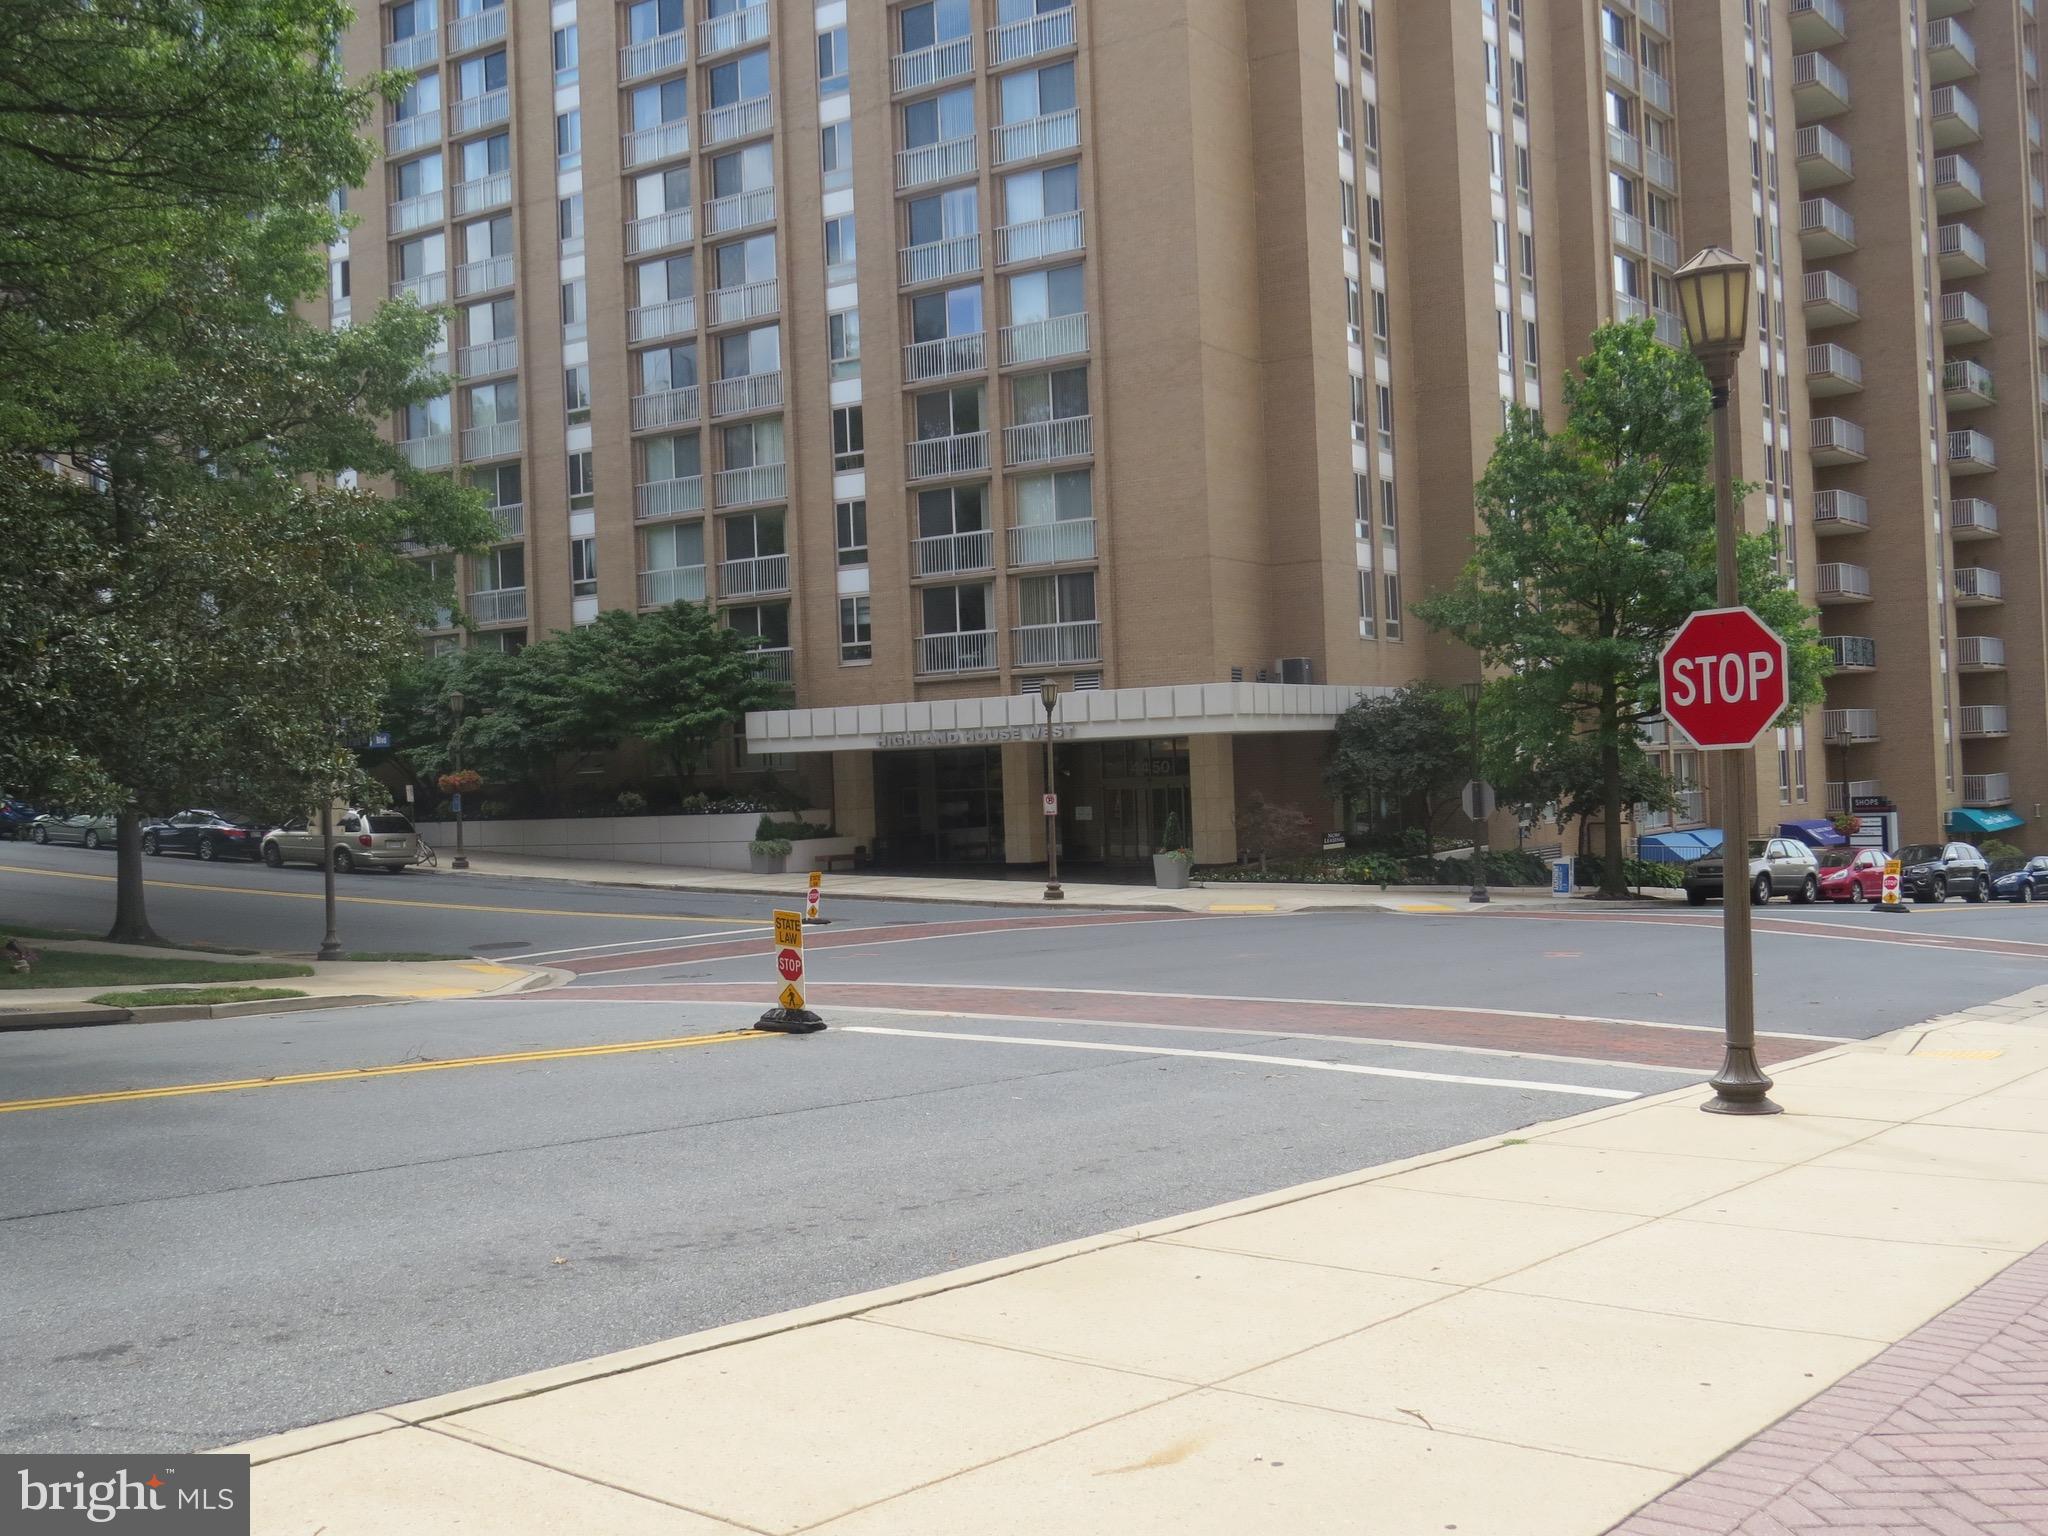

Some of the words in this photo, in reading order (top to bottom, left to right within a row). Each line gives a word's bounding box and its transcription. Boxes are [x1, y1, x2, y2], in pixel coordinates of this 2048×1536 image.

[1672, 651, 1774, 707] STOP
[876, 732, 960, 747] HIGHLAND
[962, 727, 1020, 743] HOUSE
[1022, 724, 1073, 740] WEST
[775, 917, 801, 931] STATE
[779, 931, 797, 944] LAW
[779, 957, 801, 972] STOP
